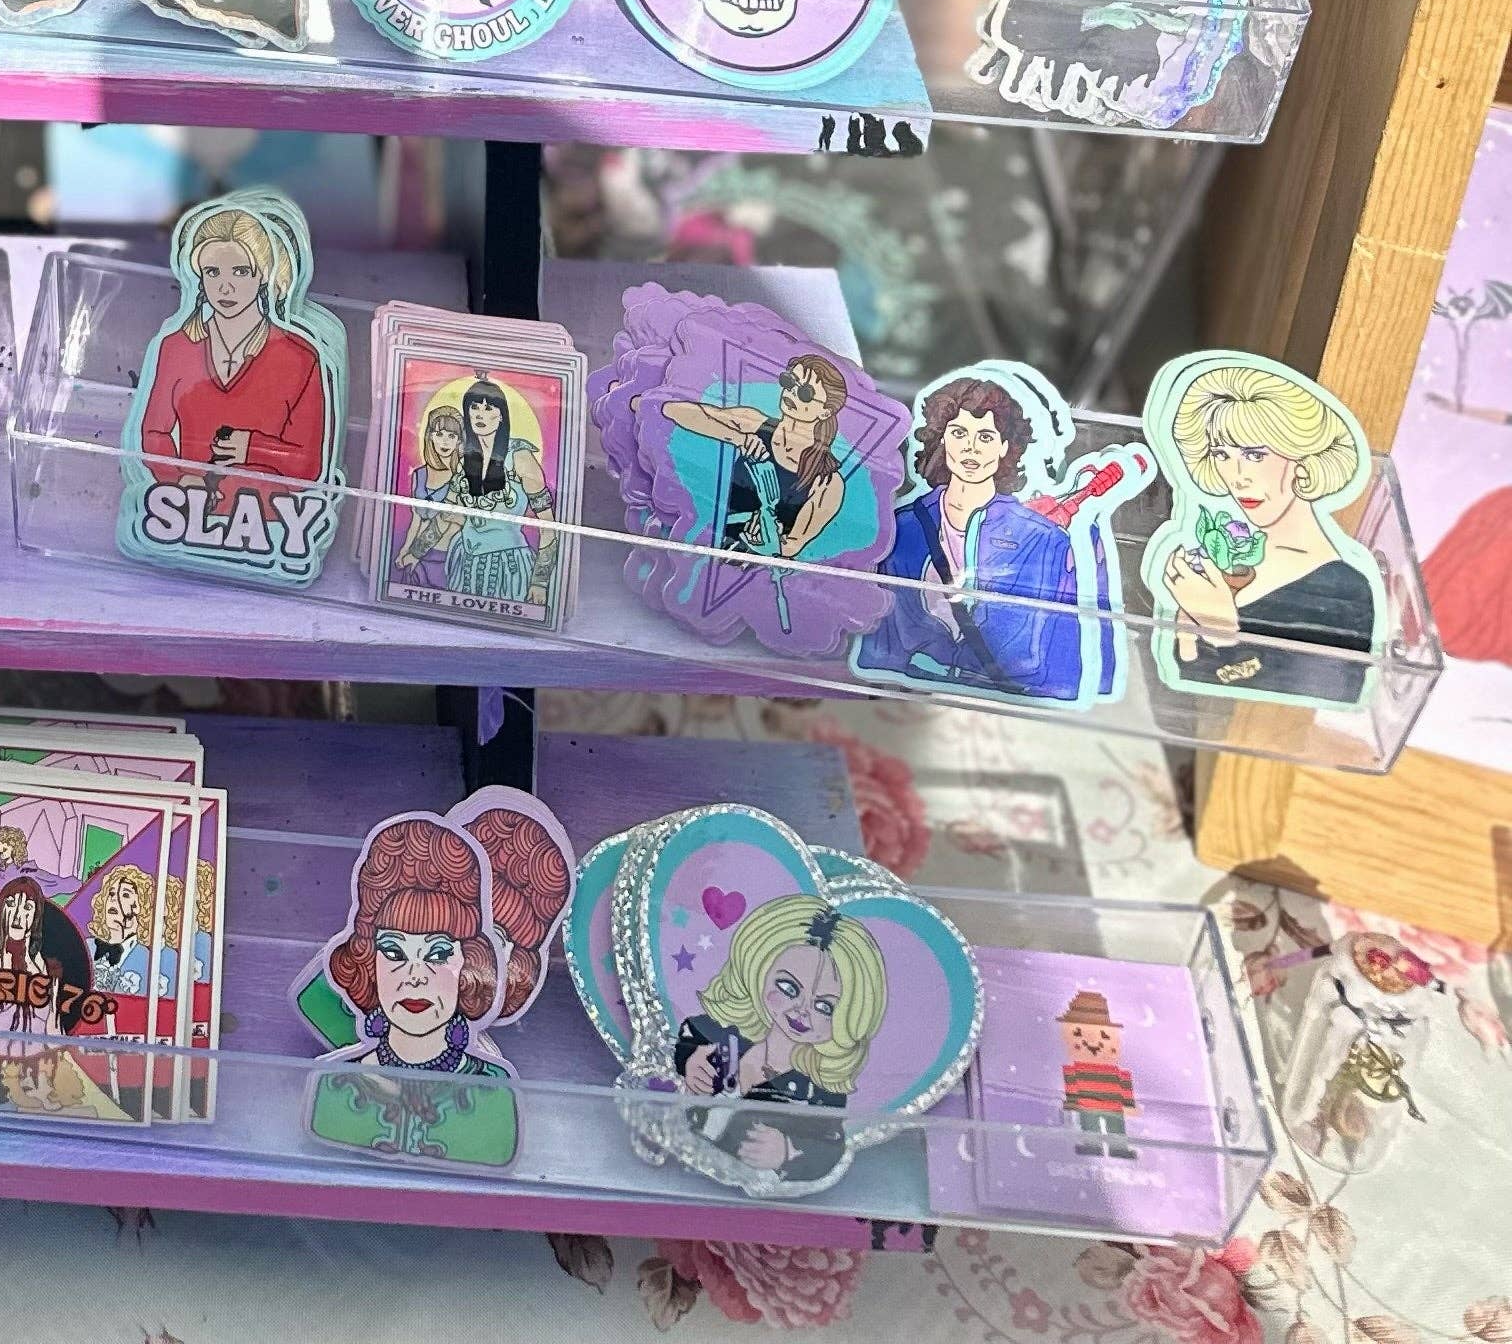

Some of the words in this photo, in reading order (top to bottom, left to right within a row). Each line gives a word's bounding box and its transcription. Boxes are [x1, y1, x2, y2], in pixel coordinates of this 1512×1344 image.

[433, 9, 531, 51] GHOUL
[142, 480, 328, 560] SLAY
[404, 588, 442, 605] THE
